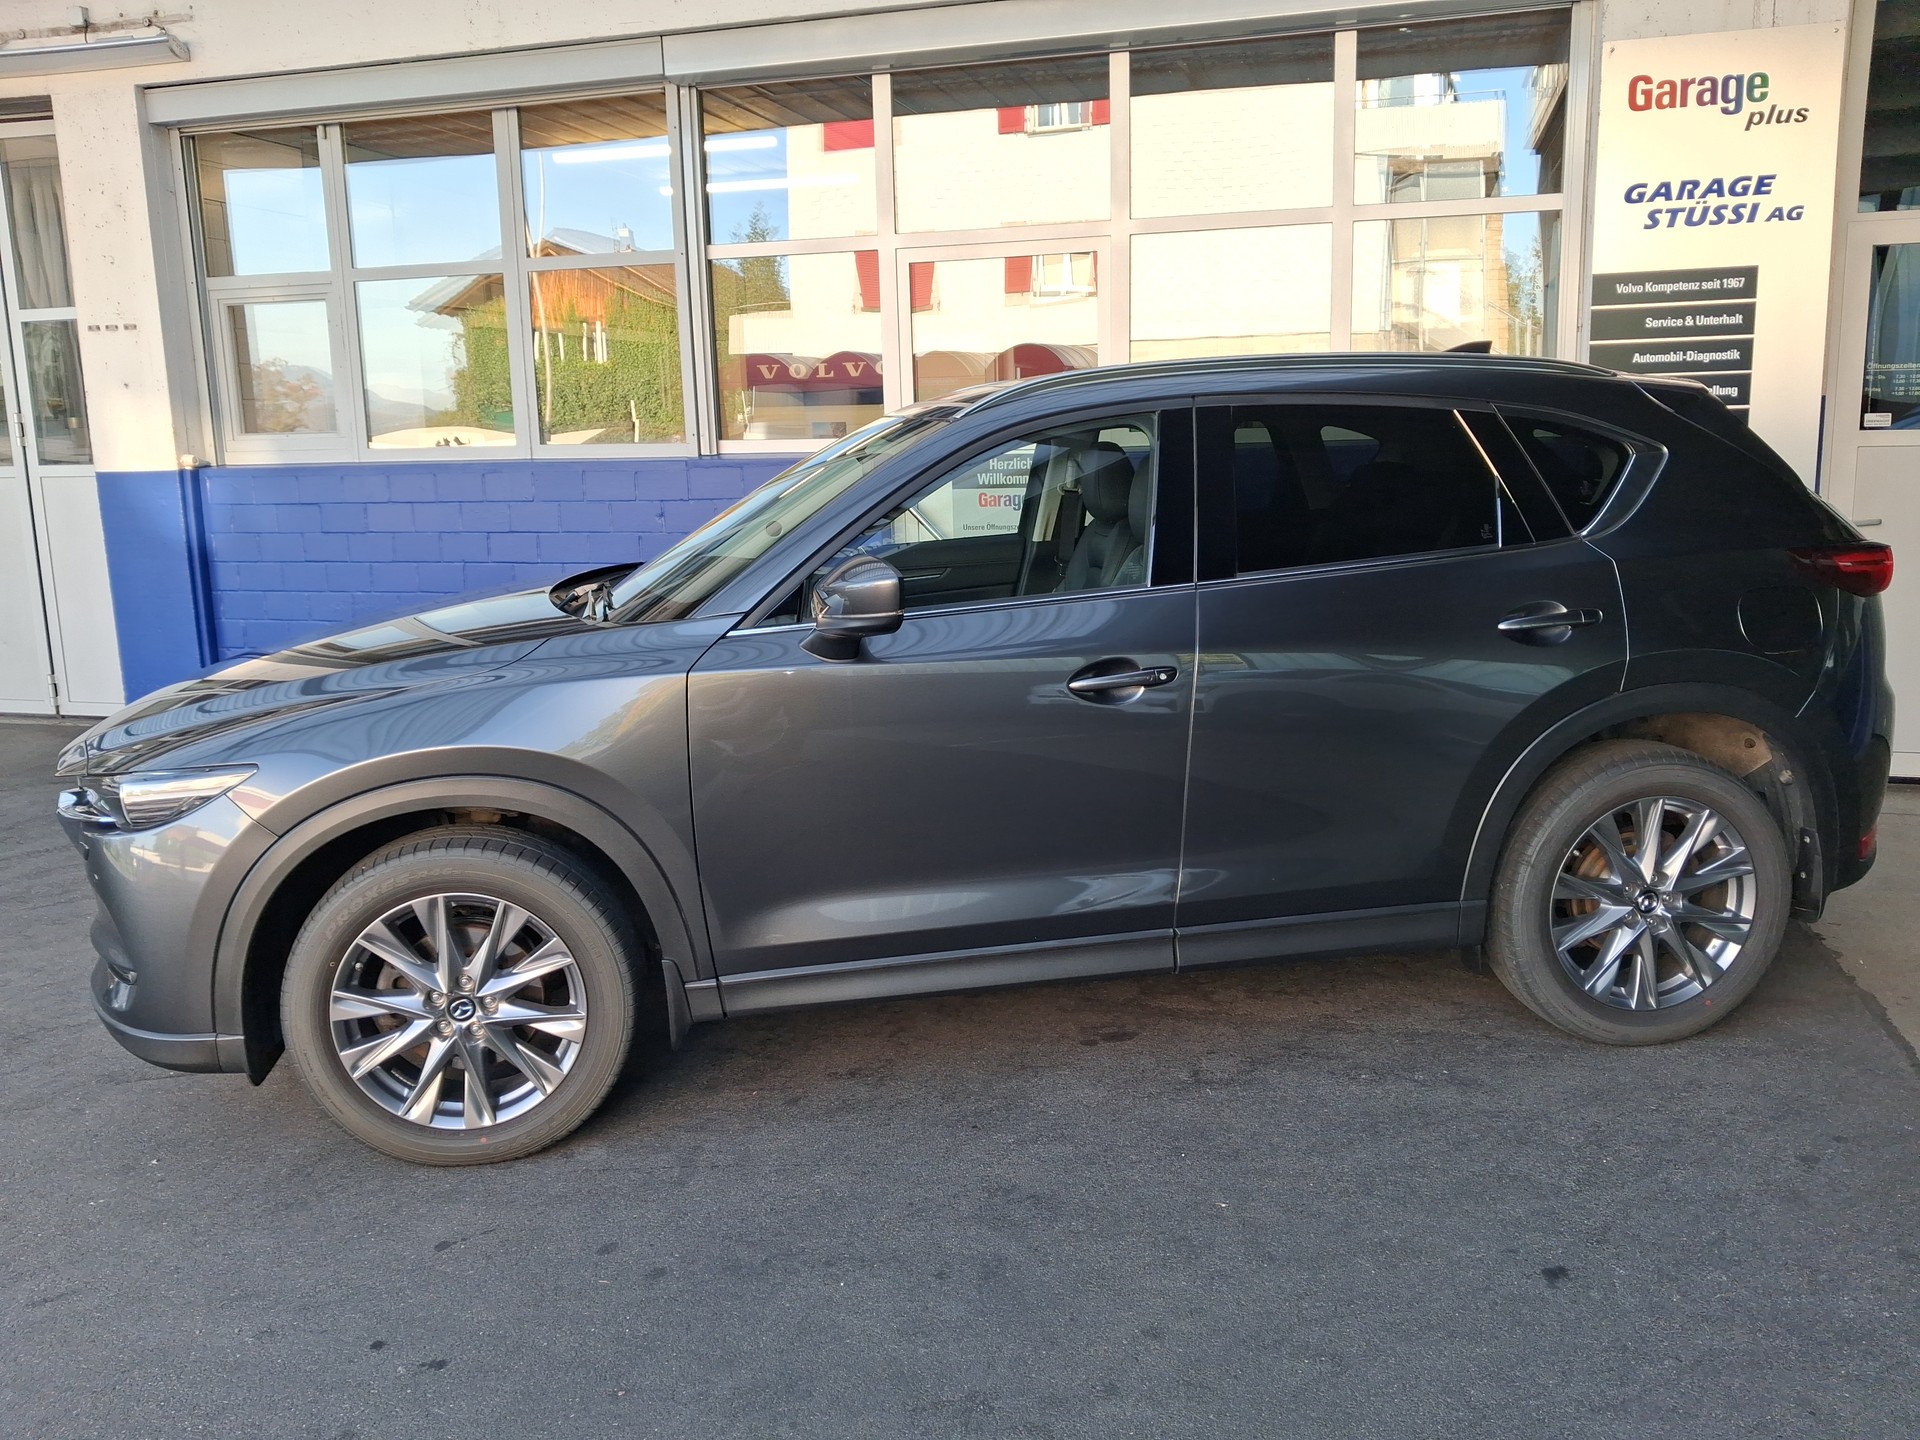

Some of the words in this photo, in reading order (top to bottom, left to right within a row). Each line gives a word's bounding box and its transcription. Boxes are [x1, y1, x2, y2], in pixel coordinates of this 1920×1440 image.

[1628, 72, 1769, 115] Garage
[1744, 104, 1809, 131] plus
[1624, 174, 1777, 204] GARAGE
[1643, 201, 1760, 229] STÜSSI
[1765, 205, 1804, 222] AG
[1616, 283, 1643, 294] Volvo
[1645, 280, 1699, 294] Kompetenz
[1702, 278, 1720, 289] seit
[1722, 277, 1745, 288] 1967
[1645, 316, 1683, 328] Service
[1685, 315, 1694, 326] &
[1696, 313, 1743, 326] Unterhalt
[1632, 349, 1740, 363] Automobil-Diagnostik
[978, 492, 1025, 511] Garag
[963, 523, 985, 531] Unsere
